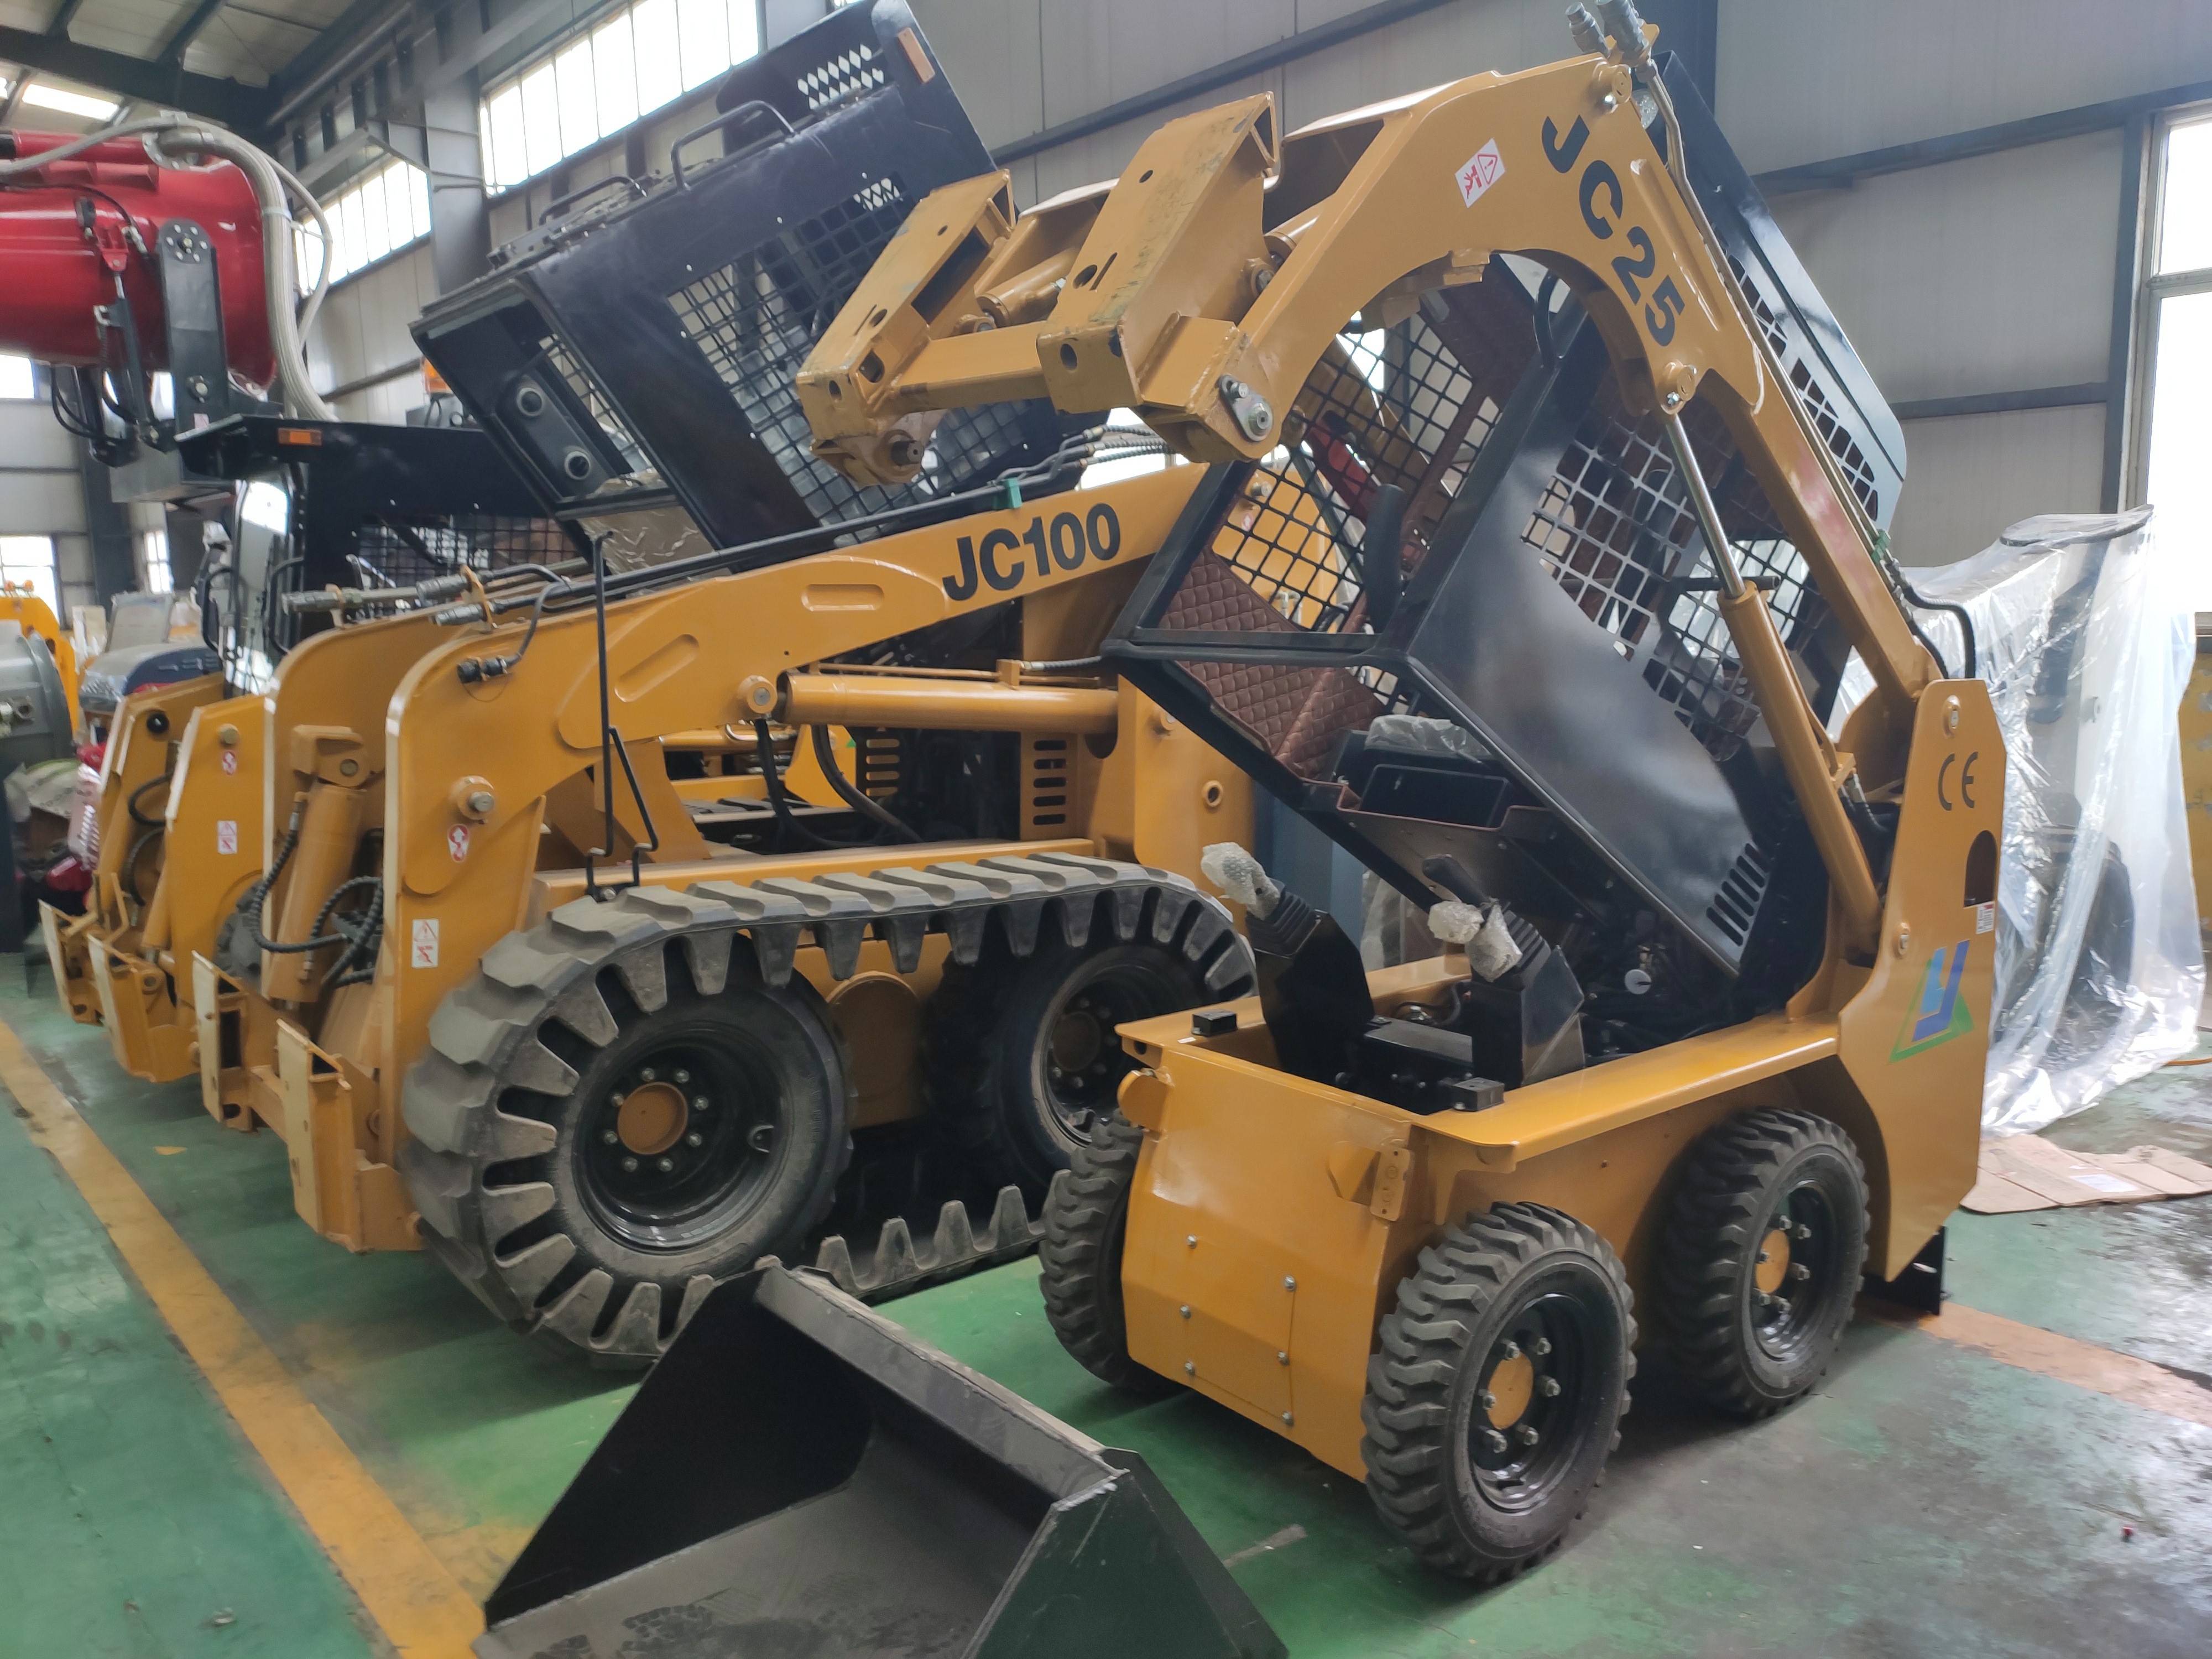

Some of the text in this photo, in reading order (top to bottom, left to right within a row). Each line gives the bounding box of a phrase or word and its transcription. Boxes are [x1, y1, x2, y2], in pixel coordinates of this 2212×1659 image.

[1541, 114, 1686, 347] JC25
[942, 502, 1122, 601] JC100
[1938, 751, 1979, 811] CE
